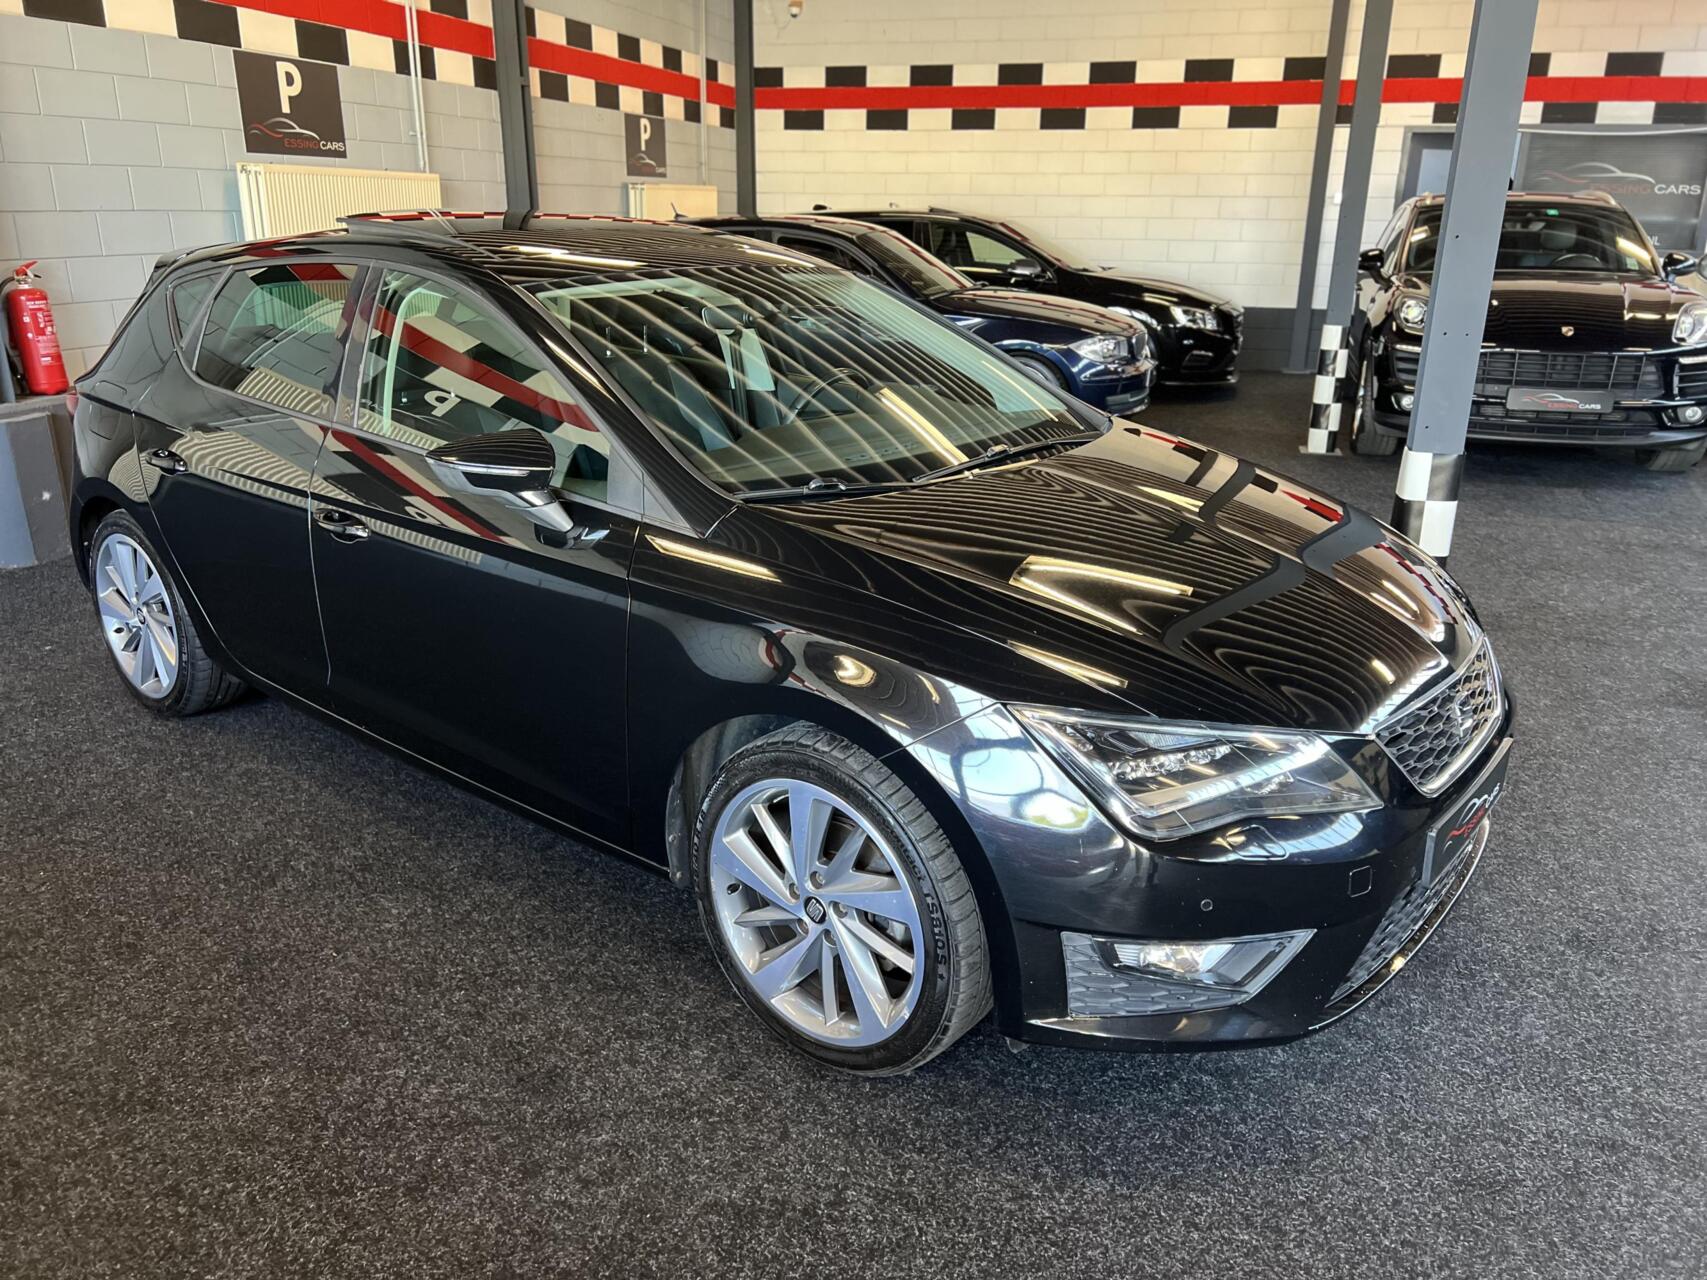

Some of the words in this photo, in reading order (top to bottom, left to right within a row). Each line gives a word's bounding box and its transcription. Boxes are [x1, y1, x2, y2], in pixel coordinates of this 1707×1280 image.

[276, 61, 302, 114] P
[320, 140, 345, 151] CARS
[640, 118, 651, 151] P
[1654, 184, 1702, 195] CARS
